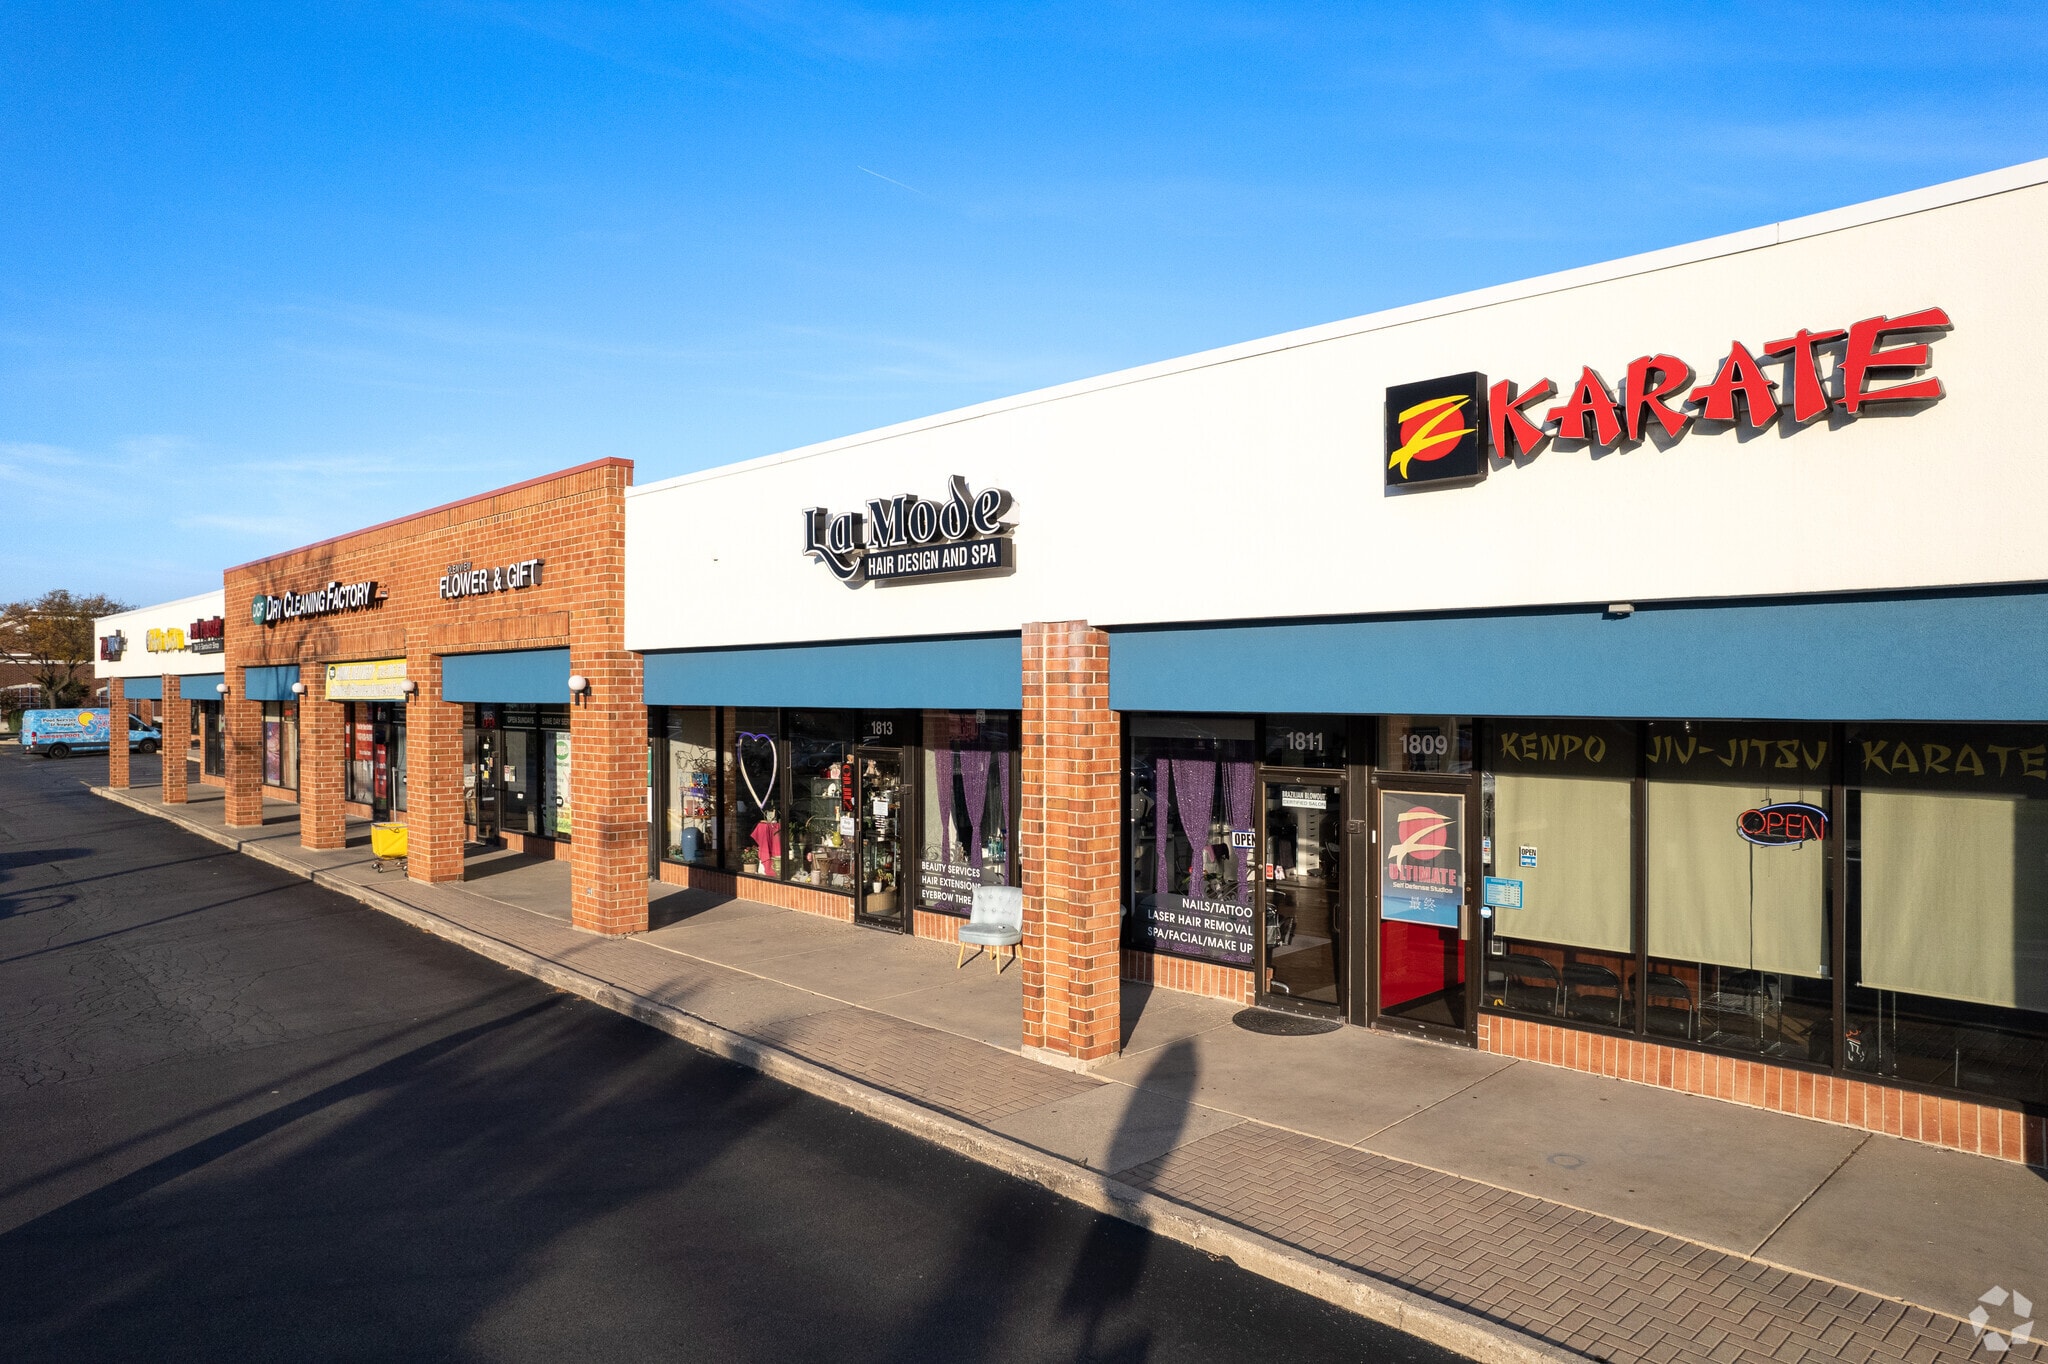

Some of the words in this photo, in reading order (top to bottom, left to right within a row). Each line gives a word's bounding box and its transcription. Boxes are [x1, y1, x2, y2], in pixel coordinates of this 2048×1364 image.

[1490, 307, 1953, 459] KARATE
[803, 507, 861, 581] La
[866, 475, 1002, 549] Mode
[447, 562, 472, 574] GLENVIEW
[868, 555, 894, 576] HAIR
[898, 550, 938, 572] DESIGN
[942, 547, 967, 568] AND
[971, 543, 997, 565] SPA
[440, 569, 487, 599] FLOWER
[493, 566, 501, 590] &
[507, 559, 538, 588] GIFT
[252, 602, 264, 618] DCF
[507, 716, 518, 724] OPEN
[871, 721, 893, 735] 1813
[1287, 732, 1323, 750] 1811
[1400, 735, 1448, 755] 1809
[1501, 732, 1606, 763] KENPO
[1862, 740, 2047, 780] KARATE
[1282, 790, 1304, 799] BRAZILIAN
[1304, 792, 1327, 801] BLOWOUT
[1739, 809, 1824, 842] OPEN
[1521, 848, 1537, 856] OPEN
[922, 861, 946, 873] BEAUTY
[948, 865, 981, 878] SERVICES
[1389, 863, 1457, 886] ULTIMATE
[922, 875, 938, 885] HAIR
[1393, 881, 1404, 889] Self
[1405, 884, 1430, 892] Defense
[1431, 885, 1453, 894] Studios
[922, 889, 953, 902] EYEBROW
[955, 895, 973, 905] THRE
[1182, 898, 1253, 918] NAILS/TATTOO
[1148, 909, 1175, 923] LASER
[1178, 914, 1201, 927] HAIR
[1204, 918, 1253, 936] REMOVAL
[1148, 926, 1236, 951] SPA/FACIAL/MAKE
[1240, 943, 1253, 954] UP
